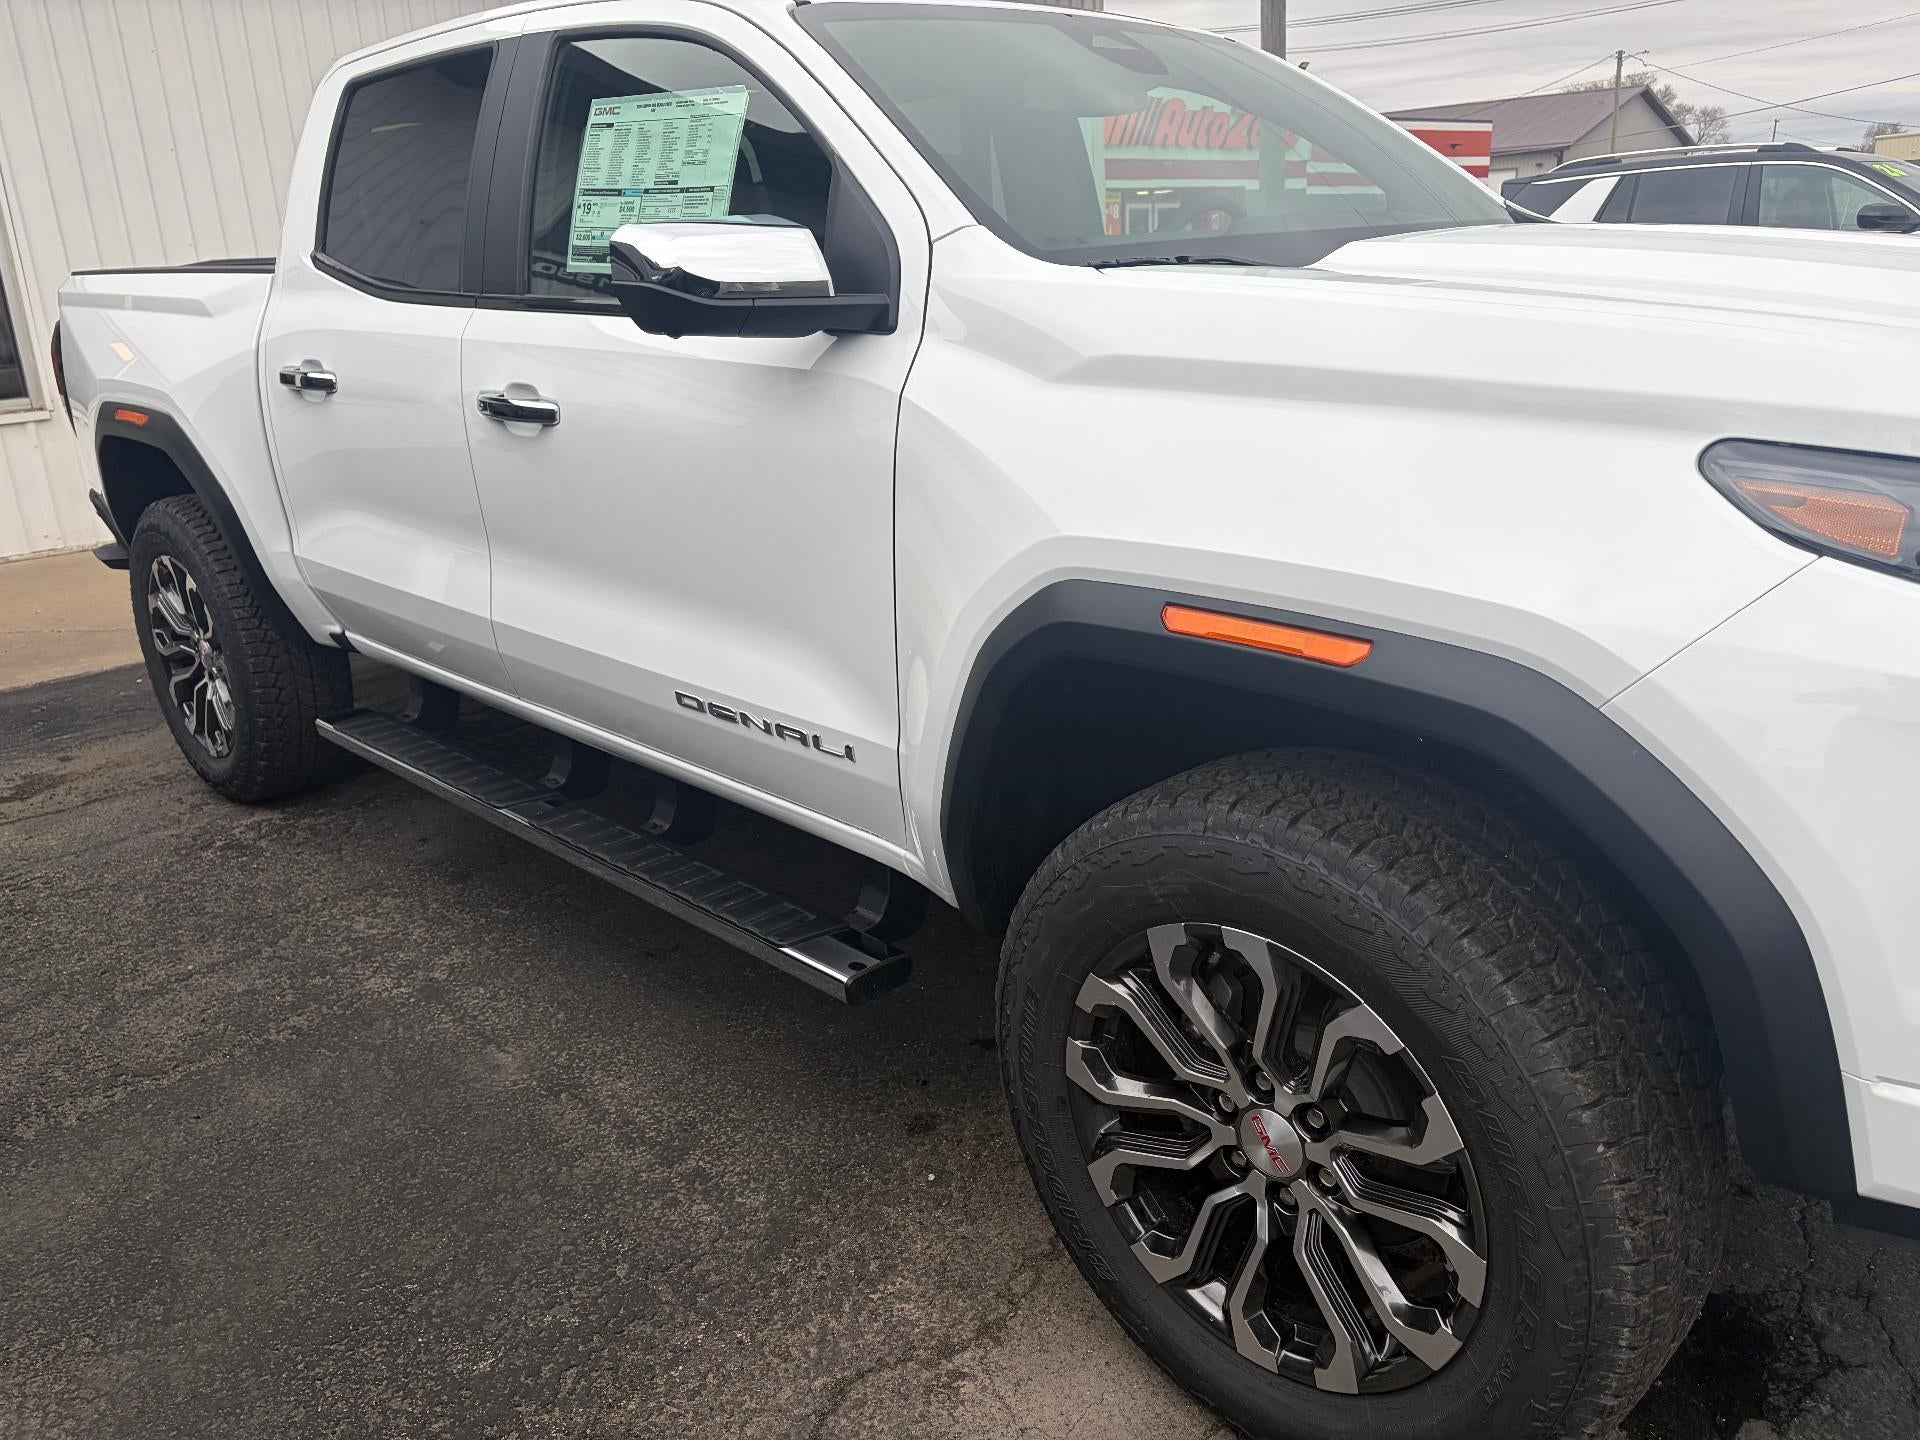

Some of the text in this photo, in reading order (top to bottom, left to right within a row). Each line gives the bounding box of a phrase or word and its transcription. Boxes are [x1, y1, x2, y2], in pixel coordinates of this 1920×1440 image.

[593, 106, 621, 116] GMC
[1153, 97, 1299, 150] AutoZo
[582, 202, 592, 215] 19
[674, 689, 857, 763] DENALI
[1250, 1114, 1291, 1174] GMC
